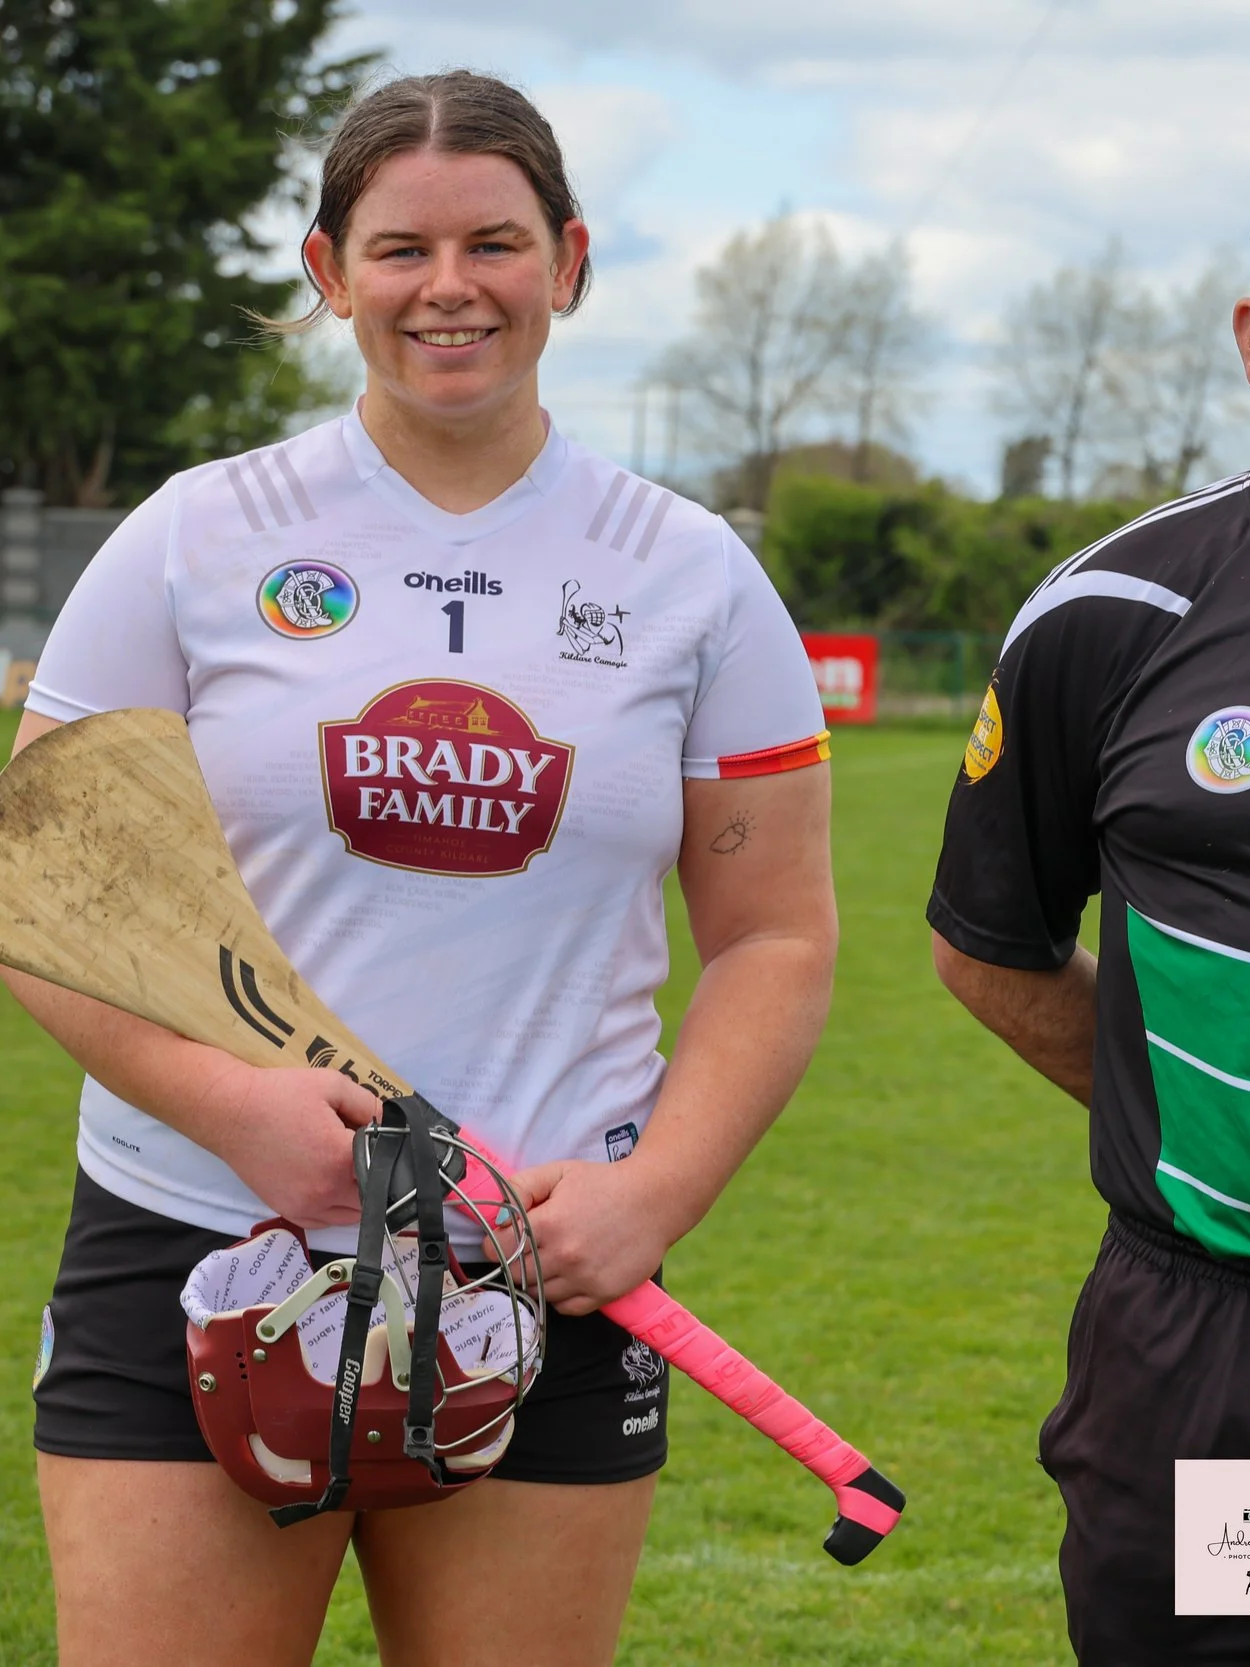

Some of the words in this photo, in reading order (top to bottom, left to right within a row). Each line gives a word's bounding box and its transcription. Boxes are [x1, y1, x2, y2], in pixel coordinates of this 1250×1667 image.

[441, 600, 464, 653] 1
[559, 650, 592, 664] Kildare
[593, 655, 628, 668] Camogie
[342, 734, 557, 795] BRADY
[357, 786, 536, 835] FAMILY
[307, 1324, 337, 1347] fabric
[467, 1303, 496, 1324] fabric
[338, 1358, 361, 1426] Cooper
